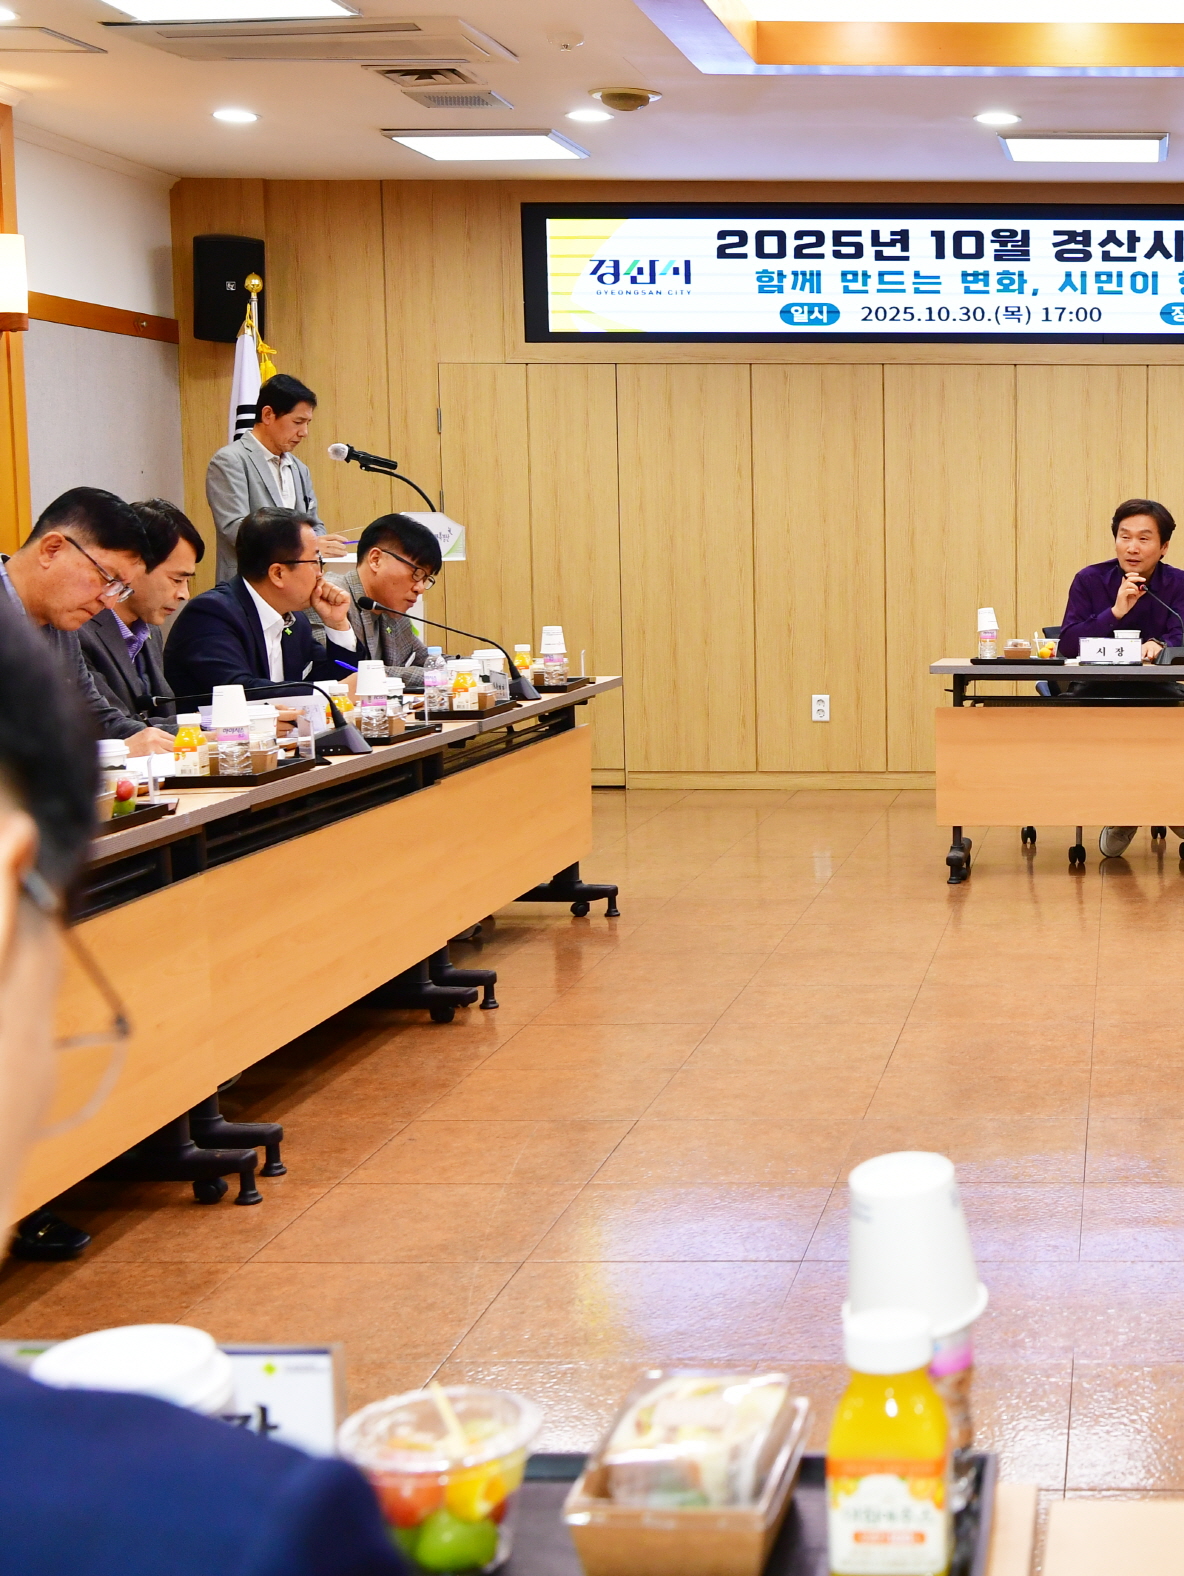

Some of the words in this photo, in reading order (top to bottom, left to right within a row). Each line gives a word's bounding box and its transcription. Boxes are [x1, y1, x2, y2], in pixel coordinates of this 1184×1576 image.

[716, 229, 911, 262] 2025년
[930, 228, 1031, 262] 10월
[1051, 230, 1184, 263] 경산시
[589, 259, 692, 286] 경산시
[755, 268, 822, 295] 함께
[840, 269, 943, 295] 만드는
[960, 269, 1039, 297] 변화,
[1057, 270, 1159, 296] 시민이
[790, 305, 828, 323] 일시
[860, 305, 1032, 326] 2025.10.30.(목)
[1041, 306, 1103, 323] 17:00
